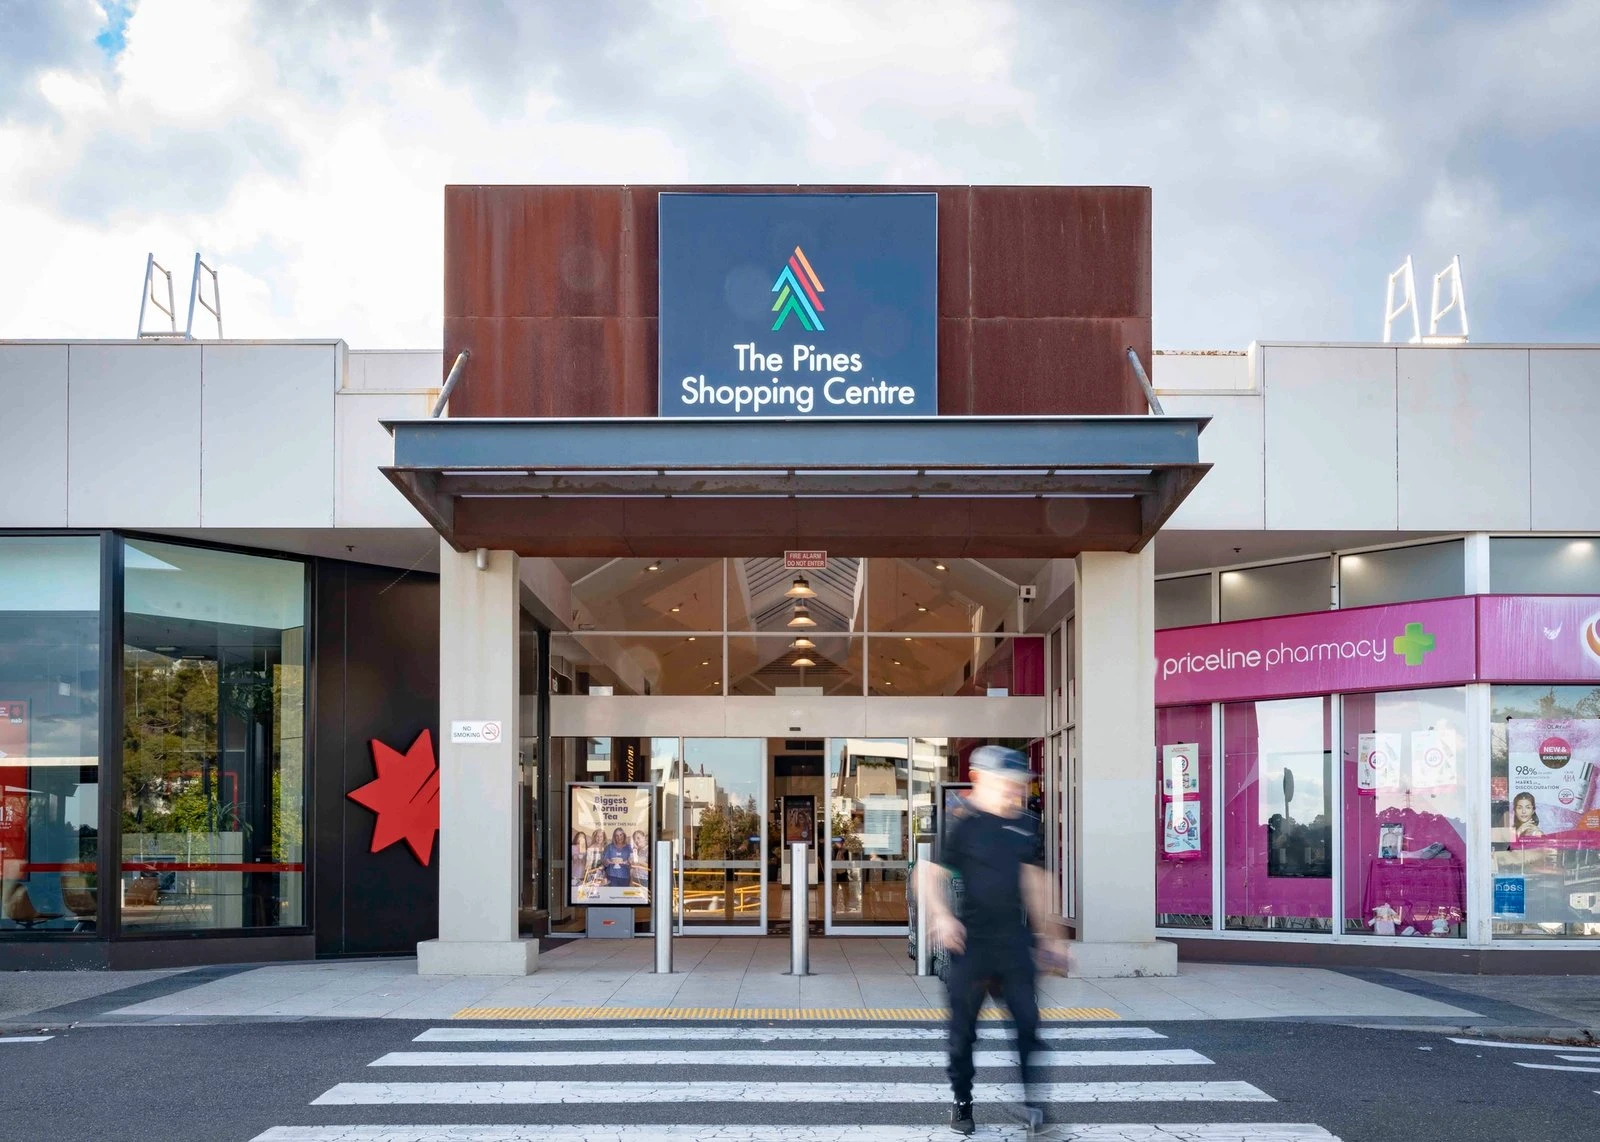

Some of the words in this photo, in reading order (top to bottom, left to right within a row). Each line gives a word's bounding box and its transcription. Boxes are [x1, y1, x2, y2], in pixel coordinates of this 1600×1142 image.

[733, 342, 783, 372] The
[793, 344, 862, 372] Pines
[681, 374, 814, 413] Shopping
[823, 376, 915, 405] Centre
[1163, 647, 1262, 681] priceline
[1265, 638, 1386, 671] pharmacy
[1515, 765, 1538, 776] 98%
[594, 795, 627, 806] Biggest
[602, 812, 618, 820] Tea
